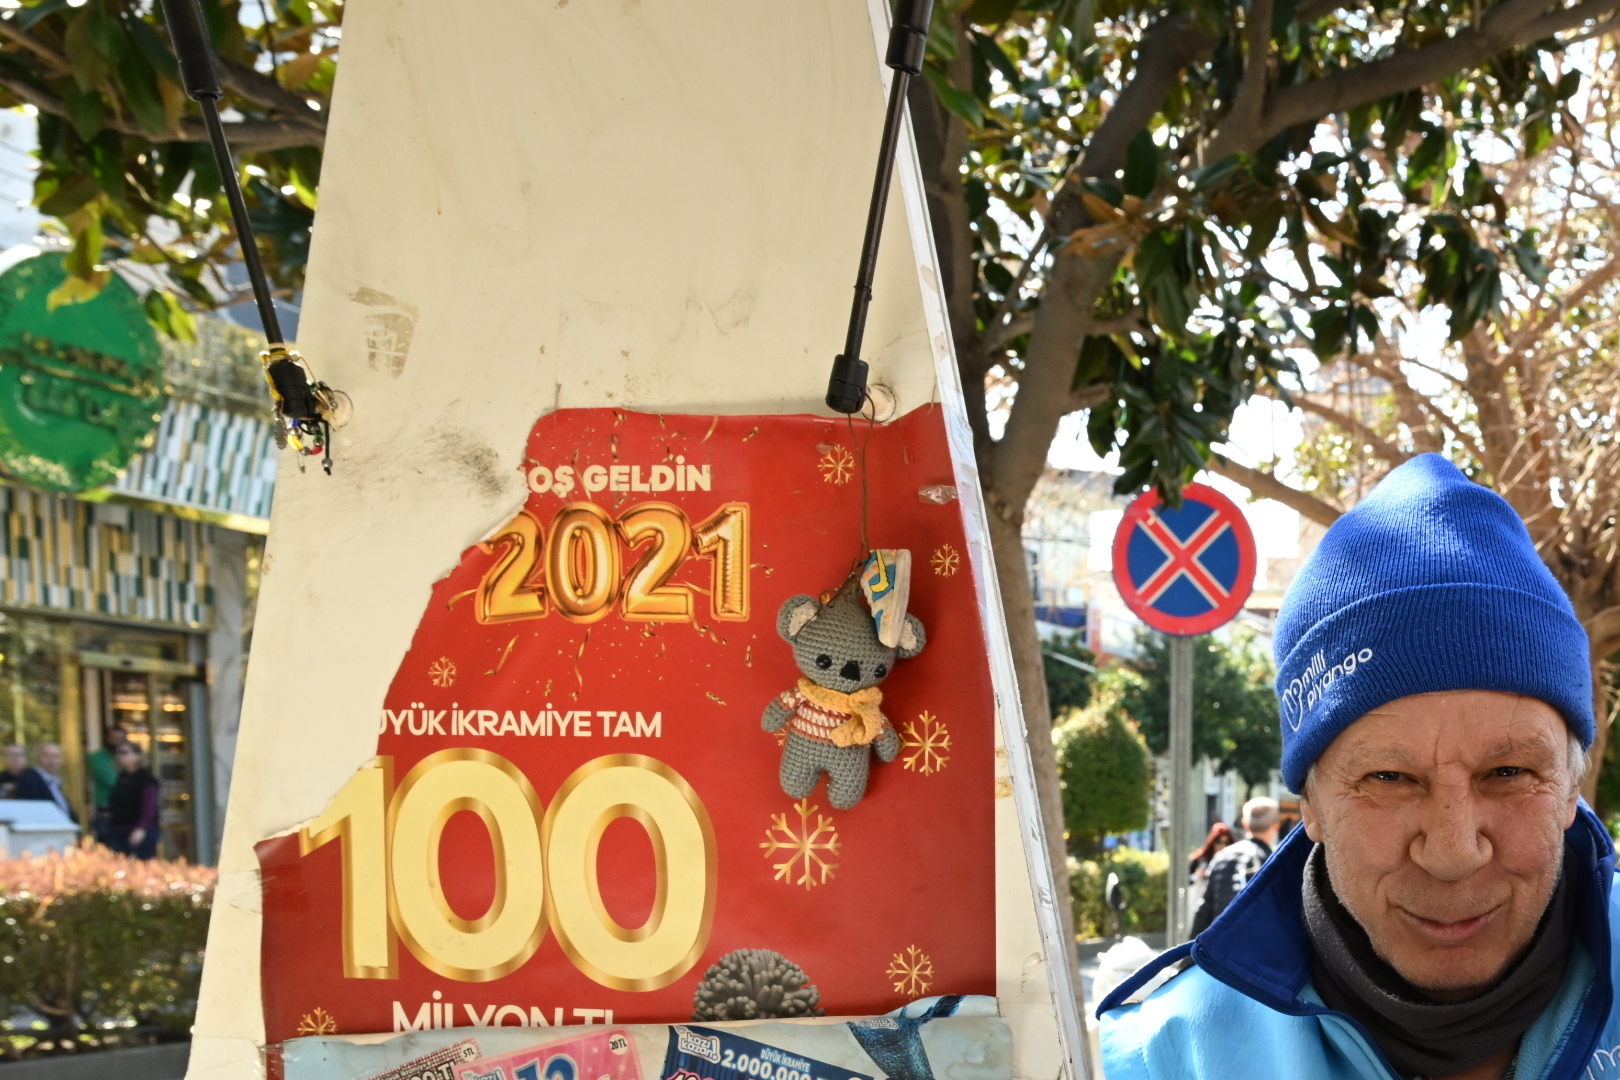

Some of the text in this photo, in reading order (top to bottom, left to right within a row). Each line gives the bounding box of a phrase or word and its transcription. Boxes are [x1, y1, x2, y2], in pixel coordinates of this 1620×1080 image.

[583, 455, 712, 493] GELDİN
[475, 501, 751, 625] 2021
[1302, 649, 1326, 688] milli
[1307, 648, 1373, 711] piyango
[451, 702, 592, 738] İKRAMİYE
[597, 710, 663, 738] TAM
[299, 747, 719, 993] 100
[393, 990, 564, 1032] MİLYON
[464, 1048, 473, 1056] 5TL
[610, 1038, 628, 1050] 20TL
[681, 1038, 718, 1060] kazan!
[760, 1048, 811, 1073] BÜYÜK İKRAMİYE
